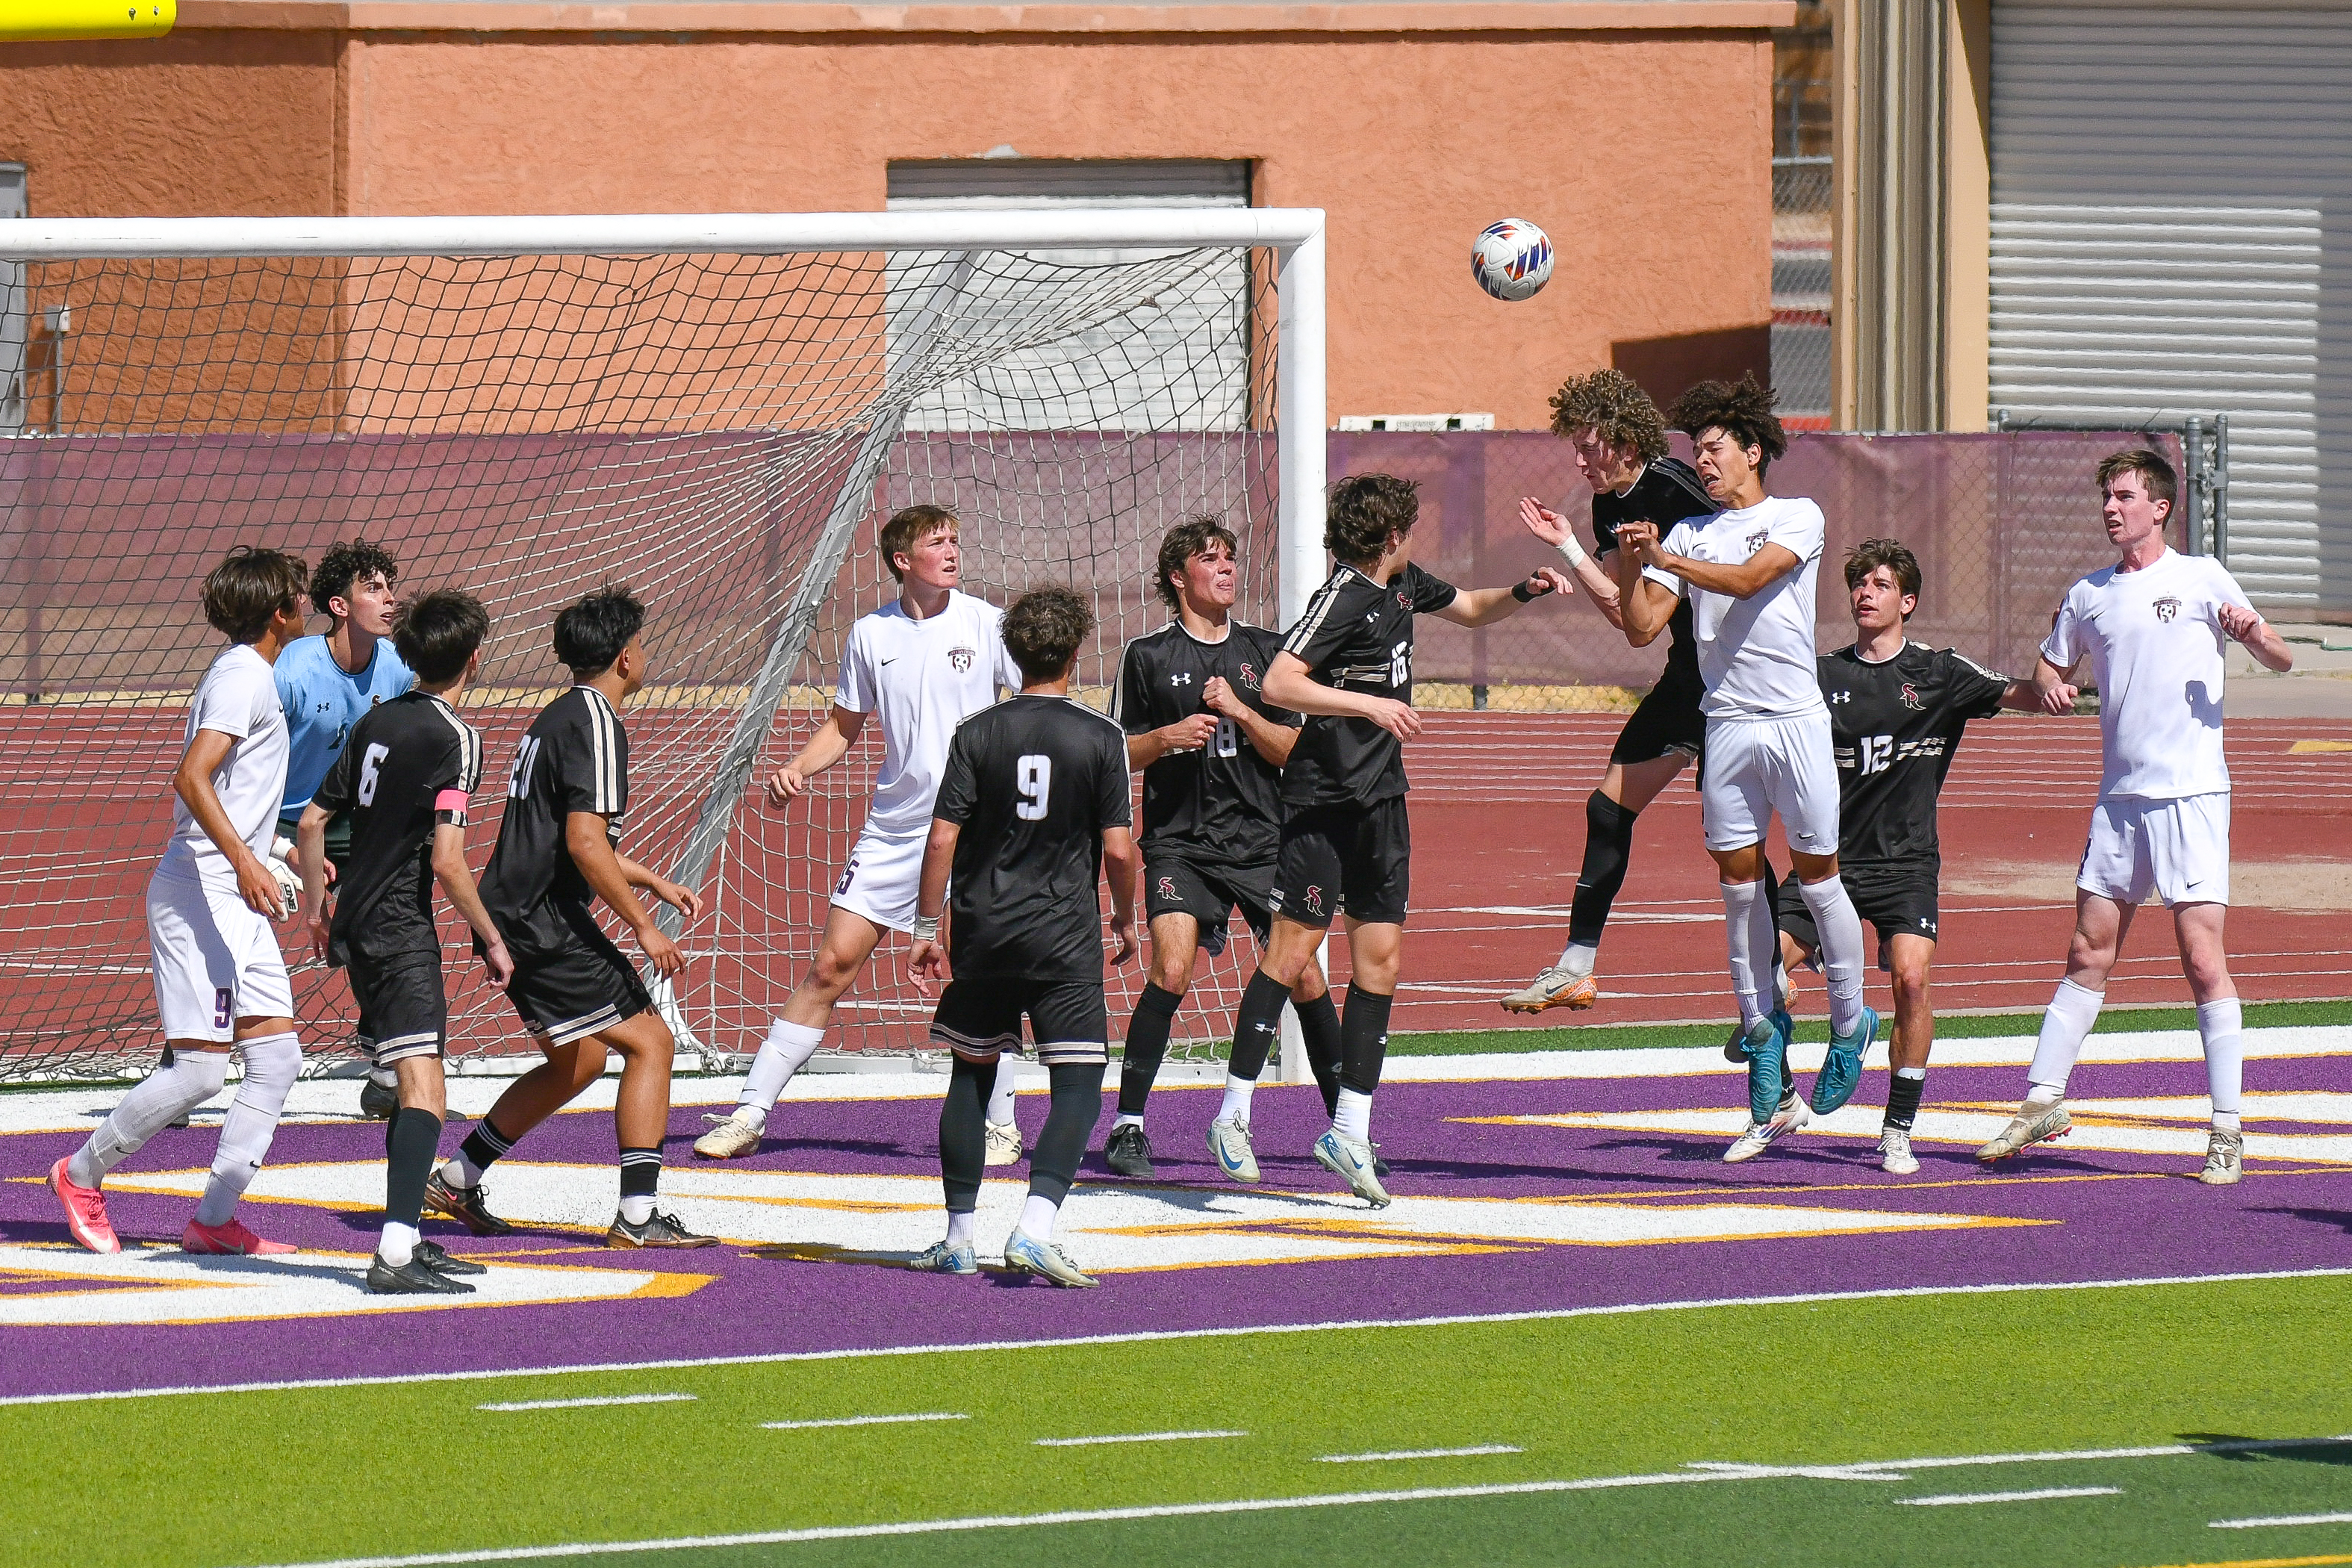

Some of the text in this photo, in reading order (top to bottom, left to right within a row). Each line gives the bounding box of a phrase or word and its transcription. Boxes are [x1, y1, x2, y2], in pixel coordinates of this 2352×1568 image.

[1391, 641, 1407, 688] 16
[358, 742, 389, 808] 6
[1860, 735, 1894, 777] 12
[1016, 754, 1051, 821] 9
[214, 987, 232, 1029] 9
